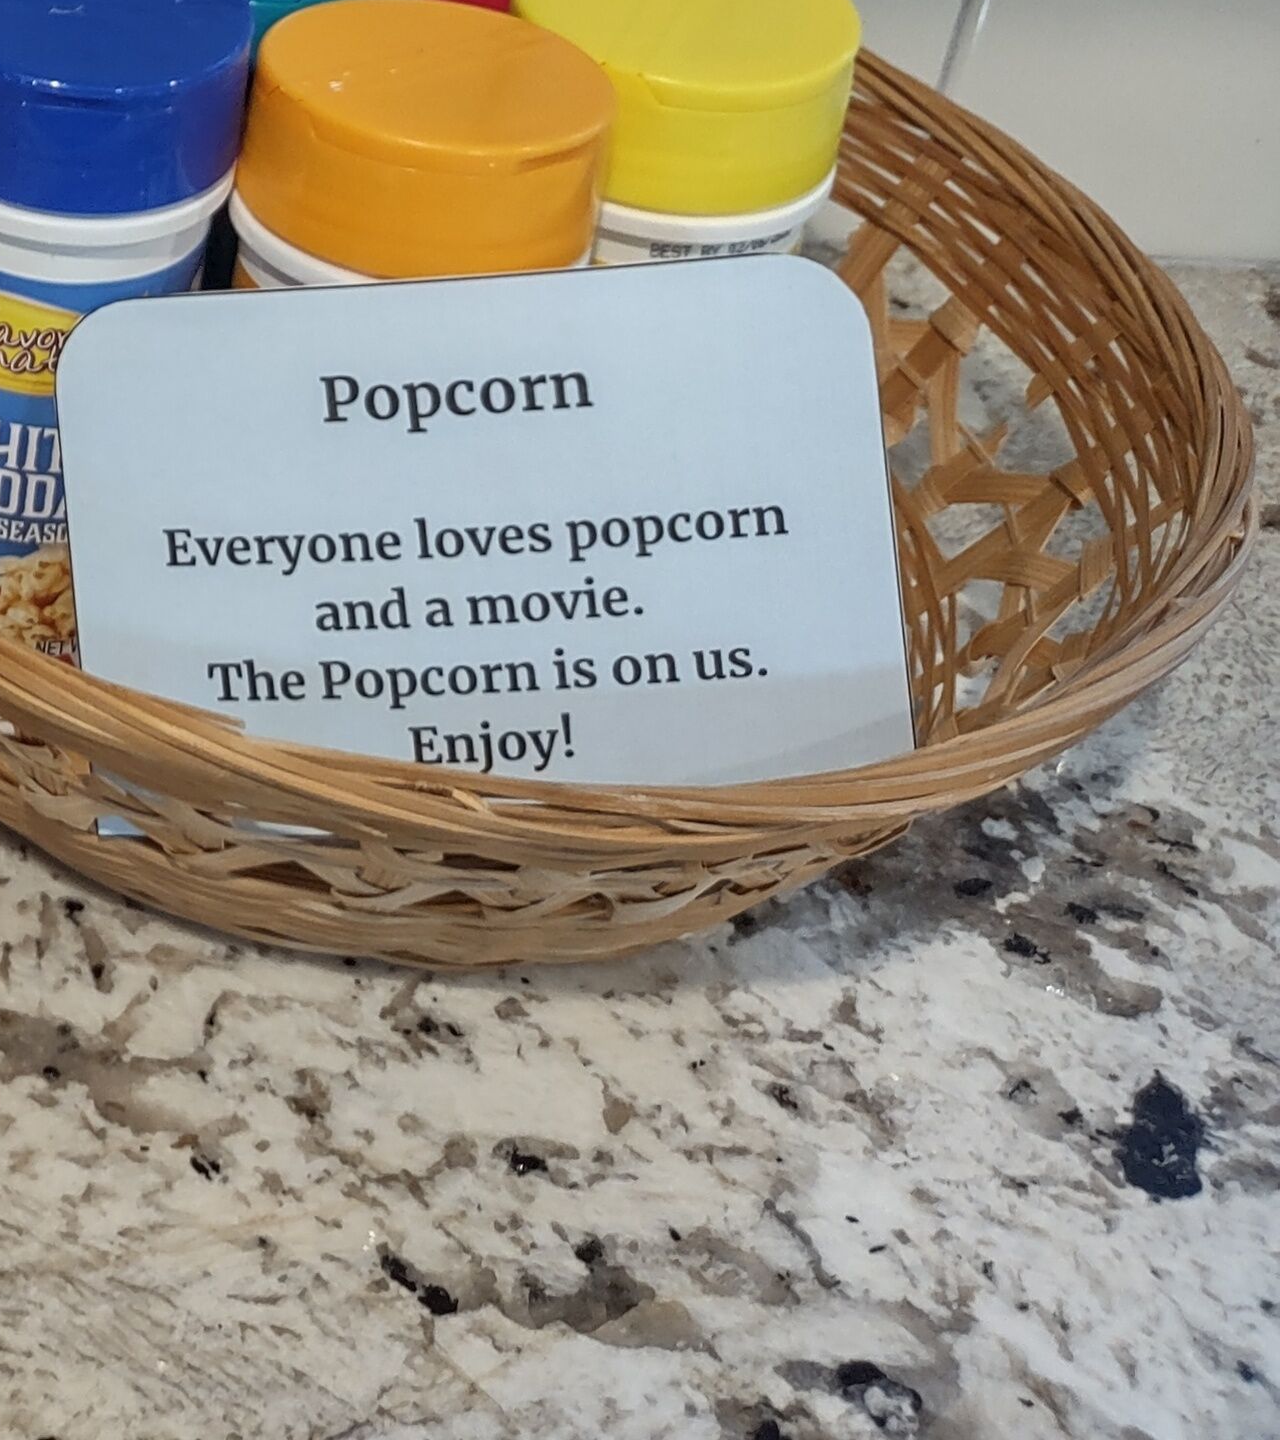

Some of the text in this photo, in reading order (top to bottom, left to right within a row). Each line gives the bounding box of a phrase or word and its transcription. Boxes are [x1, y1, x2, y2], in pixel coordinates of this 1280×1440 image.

[320, 373, 593, 433] Popcorn
[162, 506, 789, 576] Everyone loves popcorn
[316, 577, 643, 631] and a movie.
[208, 648, 767, 710] The Popcorn is on us.
[408, 712, 576, 774] Enjoy!
